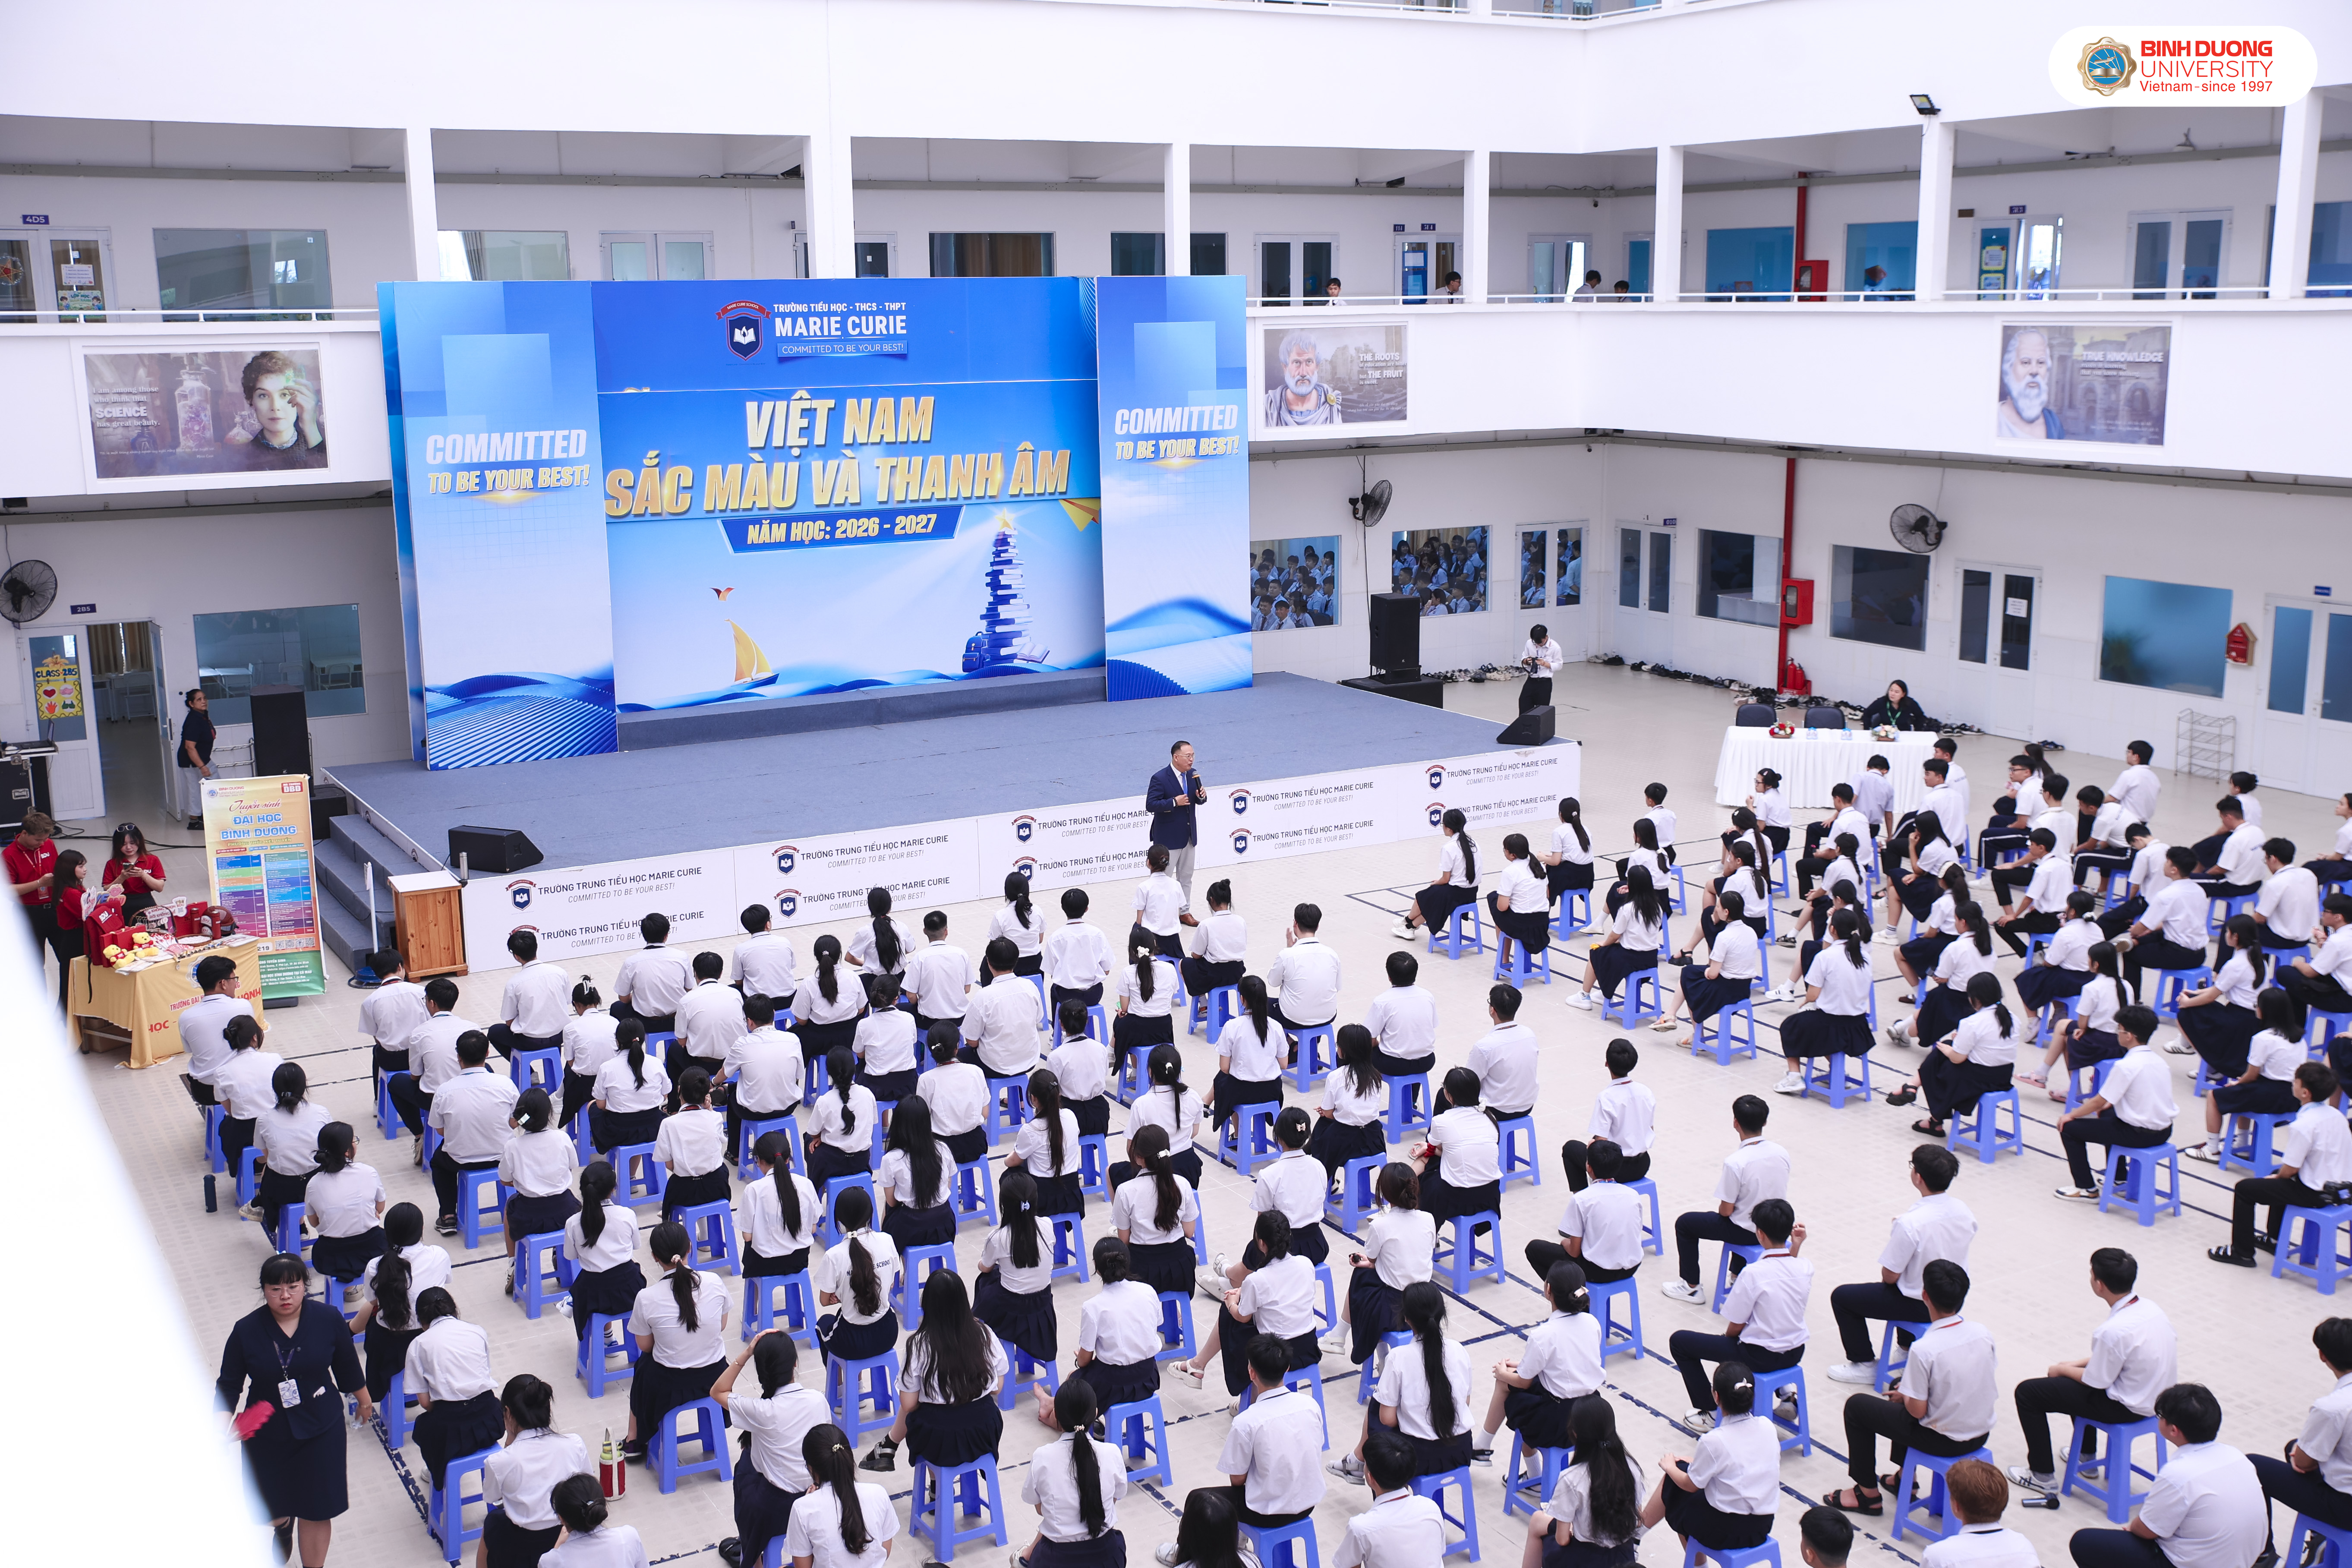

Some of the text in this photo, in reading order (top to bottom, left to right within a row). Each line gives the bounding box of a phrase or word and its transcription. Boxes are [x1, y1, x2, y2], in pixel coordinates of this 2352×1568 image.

[773, 303, 808, 312] TRƯỜNG
[810, 301, 828, 312] TIỂU
[830, 303, 847, 313] HỌC
[855, 303, 877, 311] THCS
[885, 303, 906, 311] THPT
[775, 315, 906, 337] MARIE CURIE
[782, 345, 831, 353] COMMITTED
[1375, 353, 1400, 361] ROOTS
[2083, 352, 2164, 363] TRUE KNOWLEDGE
[1383, 370, 1403, 378] FRUIT
[95, 407, 147, 419] SCIENCE
[1115, 405, 1238, 435] COMMITTED
[134, 420, 161, 428] beauty.
[746, 390, 934, 457] VIỆT NAM
[426, 429, 587, 464] COMMITTED
[1116, 435, 1240, 460] TO BE YOUR BEST!
[428, 464, 590, 494] TO BE YOUR BEST!
[605, 441, 1070, 517] SẮC MÀU VÀ THANH ÂM
[747, 520, 786, 545] NĂM
[791, 521, 831, 545] HỌC:
[835, 517, 880, 539] 2026
[894, 514, 937, 534] 2027
[35, 668, 78, 678] CLASS 2B5
[1447, 769, 1471, 778] TRƯỜNG
[1472, 766, 1492, 775] TRUNG
[1494, 762, 1507, 772] TIỂU
[1508, 763, 1520, 771] HỌC
[1521, 760, 1539, 768] MARIE
[1252, 782, 1374, 803] TRƯỜNG TRUNG TIỂU HỌC MARIE CURIE
[229, 799, 281, 814] Tuyển sinh
[1274, 801, 1305, 811] COMMITTED
[233, 814, 282, 826] ĐẠI HỌC
[221, 826, 296, 839] BÌNH DƯƠNG
[801, 835, 949, 861] TRƯỜNG TRUNG TIỂU HỌC MARIE CURIE
[538, 867, 702, 895] TRƯỜNG TRUNG TIỂU HỌC MARIE CURIE
[568, 891, 611, 903] COMMITTED
[635, 886, 653, 895] YOUR
[656, 883, 675, 892] BEST!
[99, 911, 108, 921] BDU
